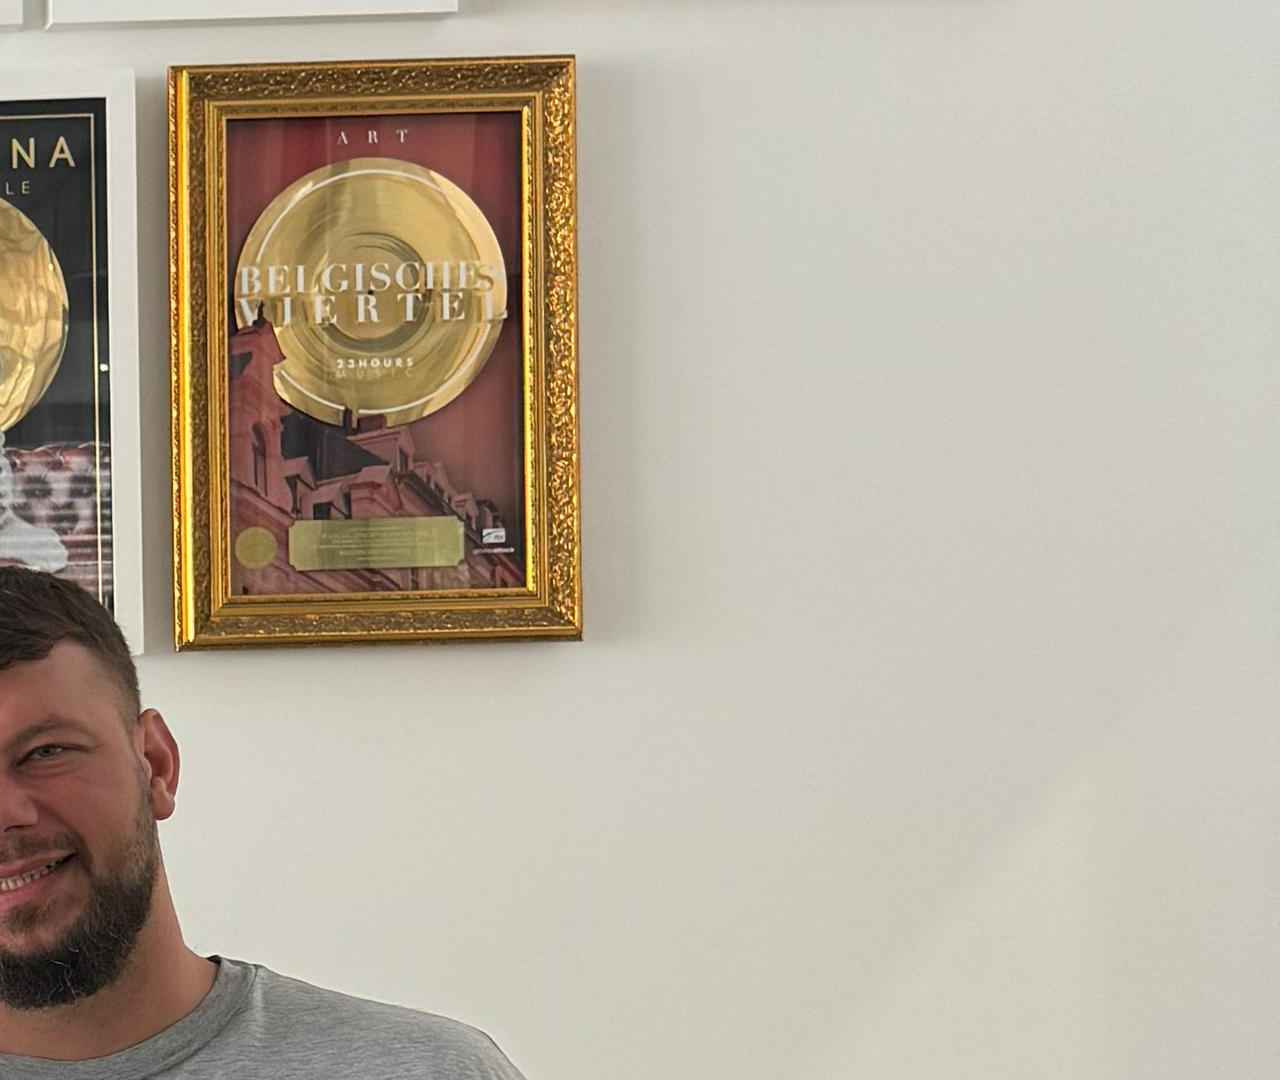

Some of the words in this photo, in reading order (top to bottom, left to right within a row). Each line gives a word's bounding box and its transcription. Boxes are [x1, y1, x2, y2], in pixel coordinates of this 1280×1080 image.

[337, 128, 408, 144] ART
[239, 259, 493, 295] BELGISCHES
[236, 289, 508, 328] VIERTEL
